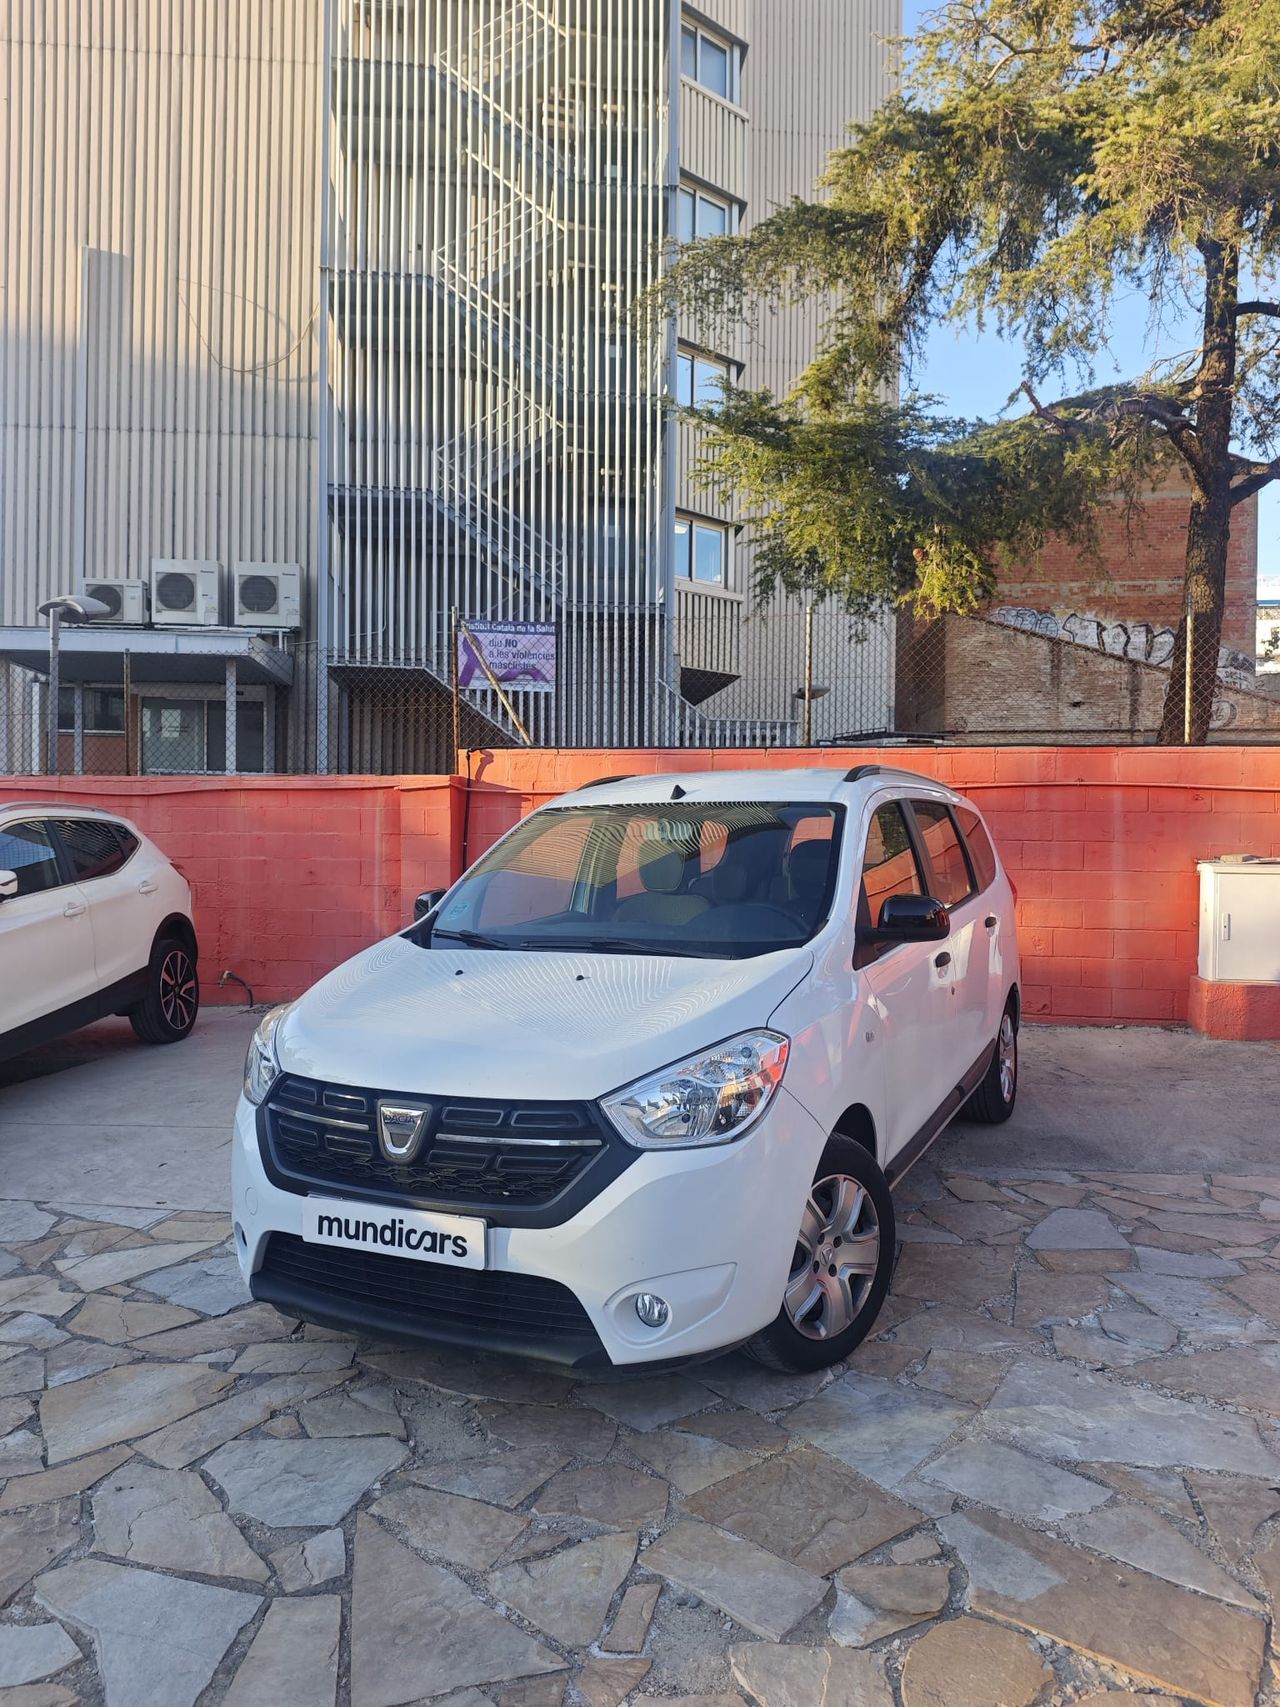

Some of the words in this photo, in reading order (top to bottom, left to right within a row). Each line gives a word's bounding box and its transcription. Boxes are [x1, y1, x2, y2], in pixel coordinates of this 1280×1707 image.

[464, 621, 490, 630] nstitut
[517, 624, 526, 632] de
[528, 624, 535, 633] la
[536, 624, 555, 633] Salut
[504, 638, 518, 648] NO
[488, 651, 494, 659] a
[497, 650, 510, 659] les
[384, 1114, 415, 1125] DACIA
[318, 1214, 468, 1258] mundicars
